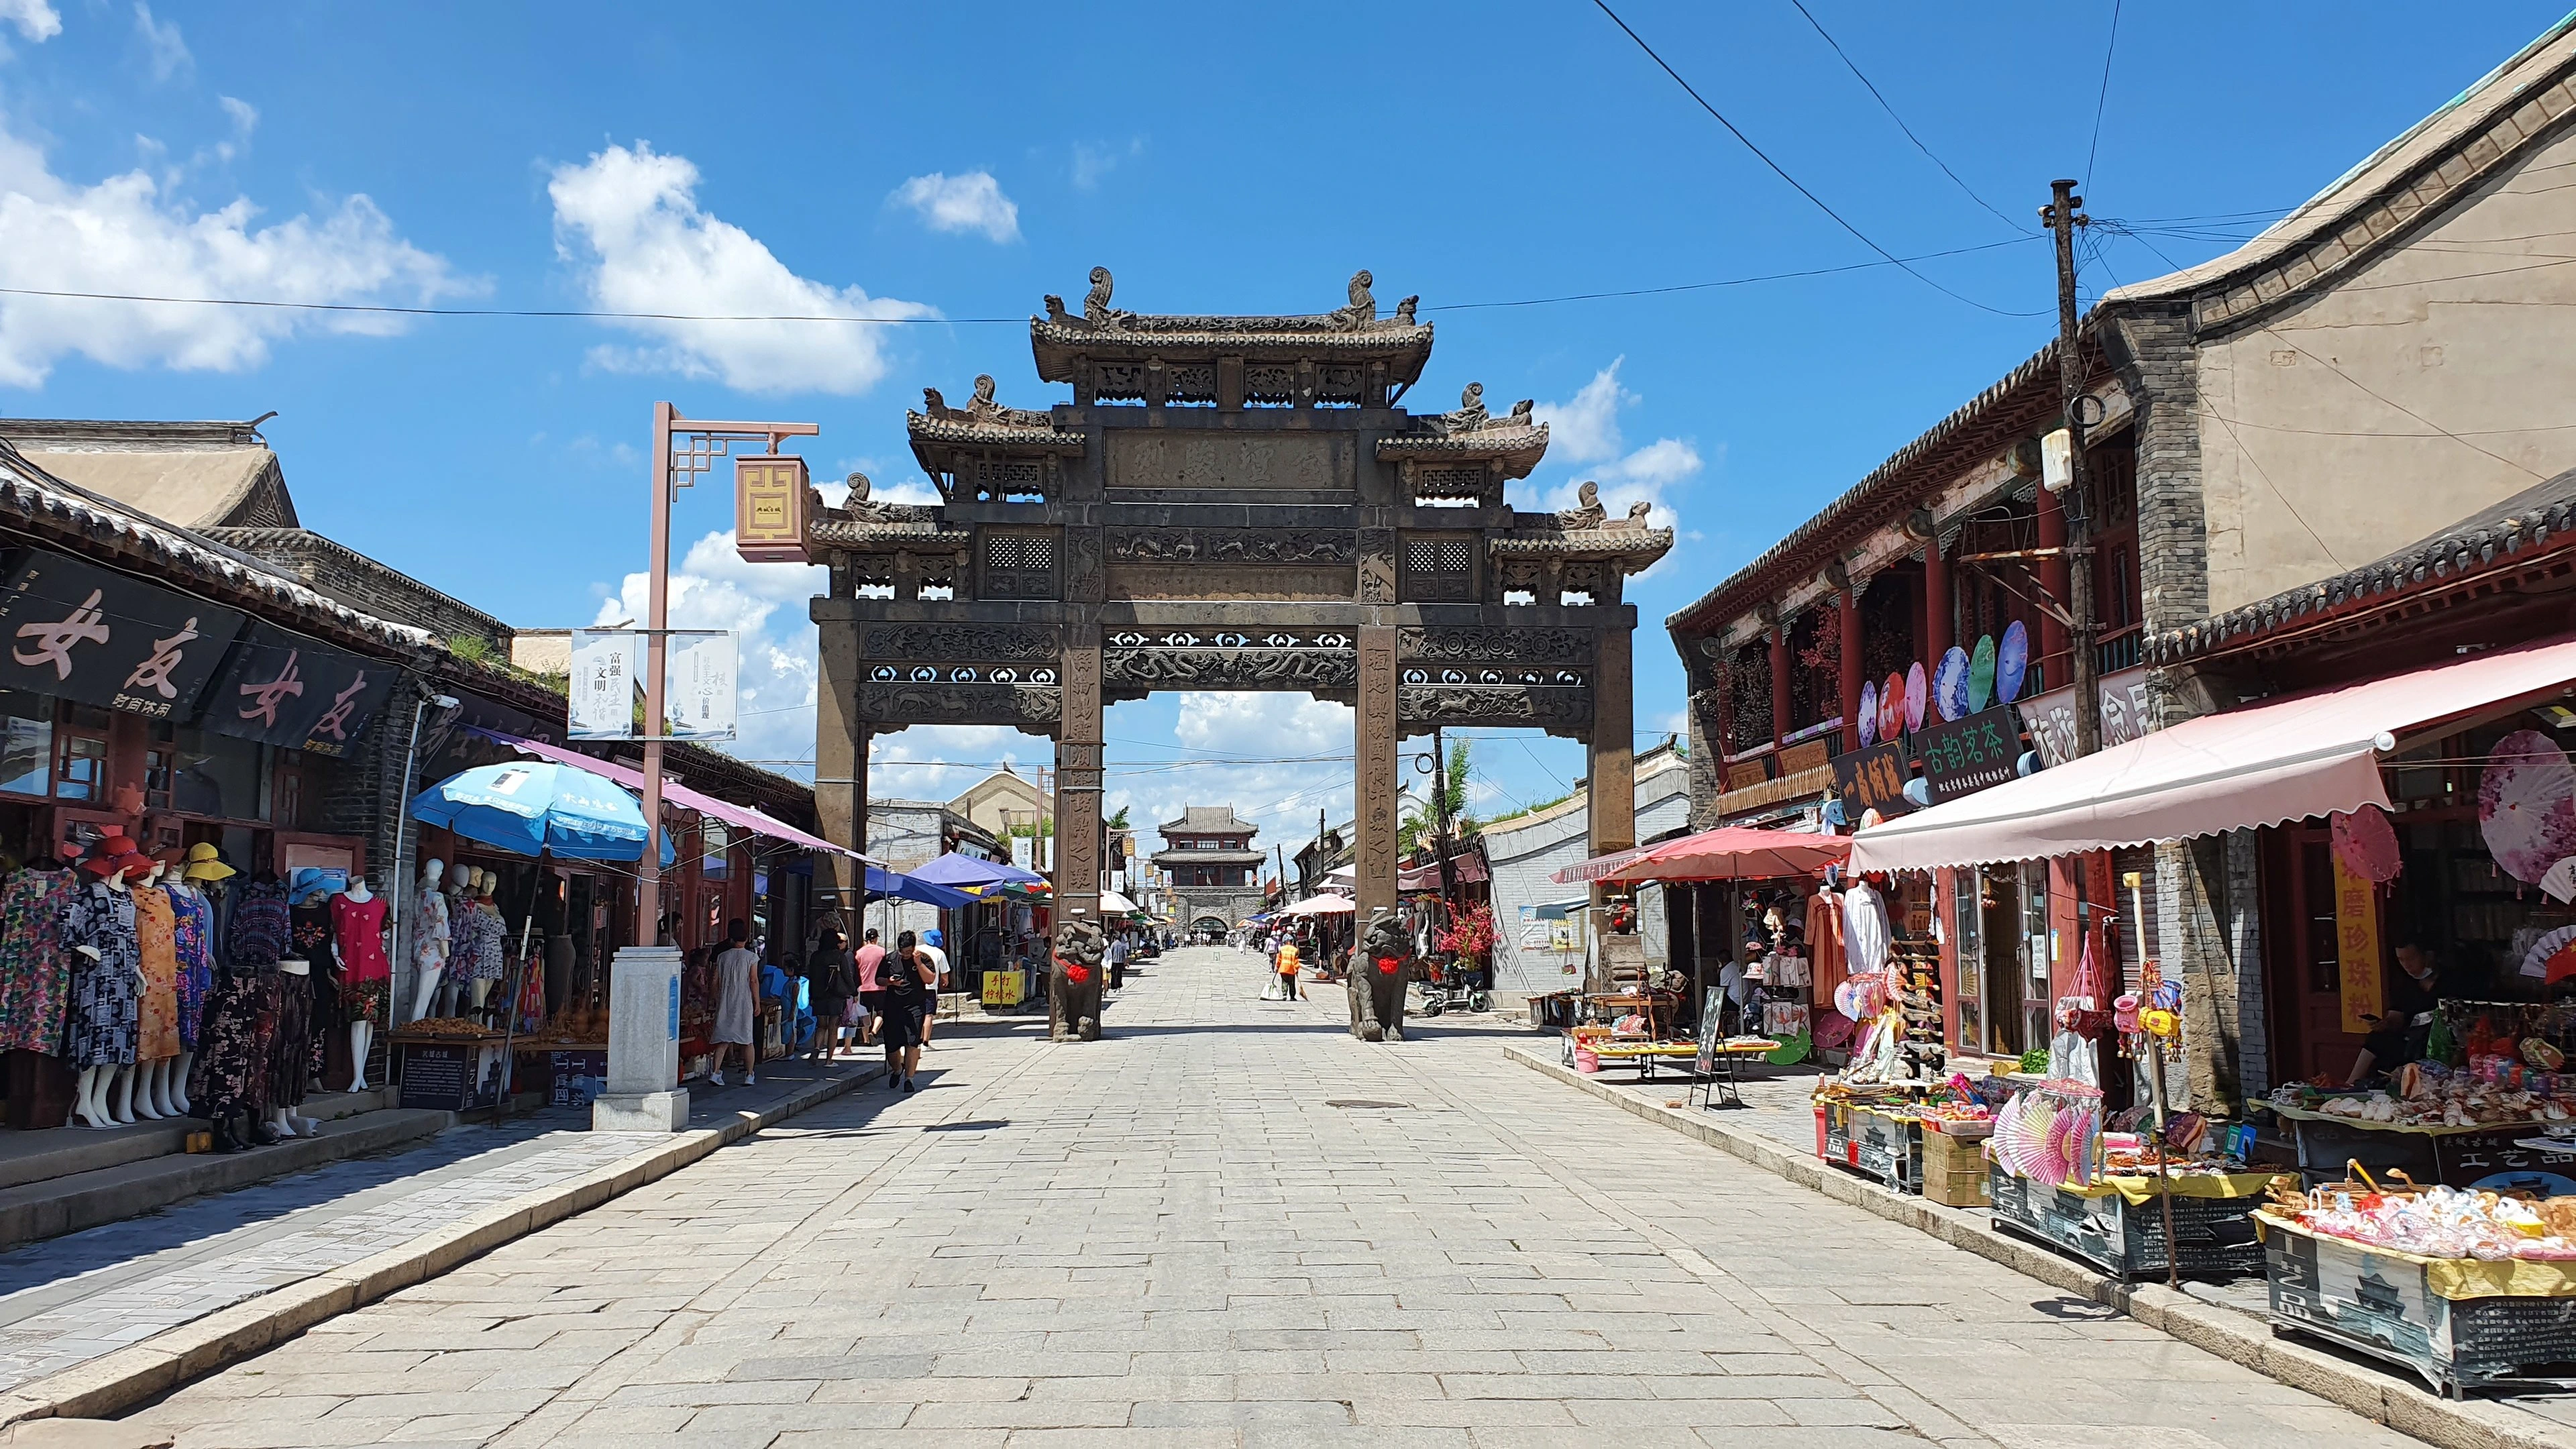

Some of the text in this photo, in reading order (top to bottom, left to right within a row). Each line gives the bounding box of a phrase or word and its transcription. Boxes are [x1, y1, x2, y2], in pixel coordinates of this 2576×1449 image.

[13, 589, 199, 699] 女友
[239, 649, 367, 741] 女友
[1925, 720, 2003, 773] 古韵茗茶
[2459, 1149, 2574, 1168] 工艺品
